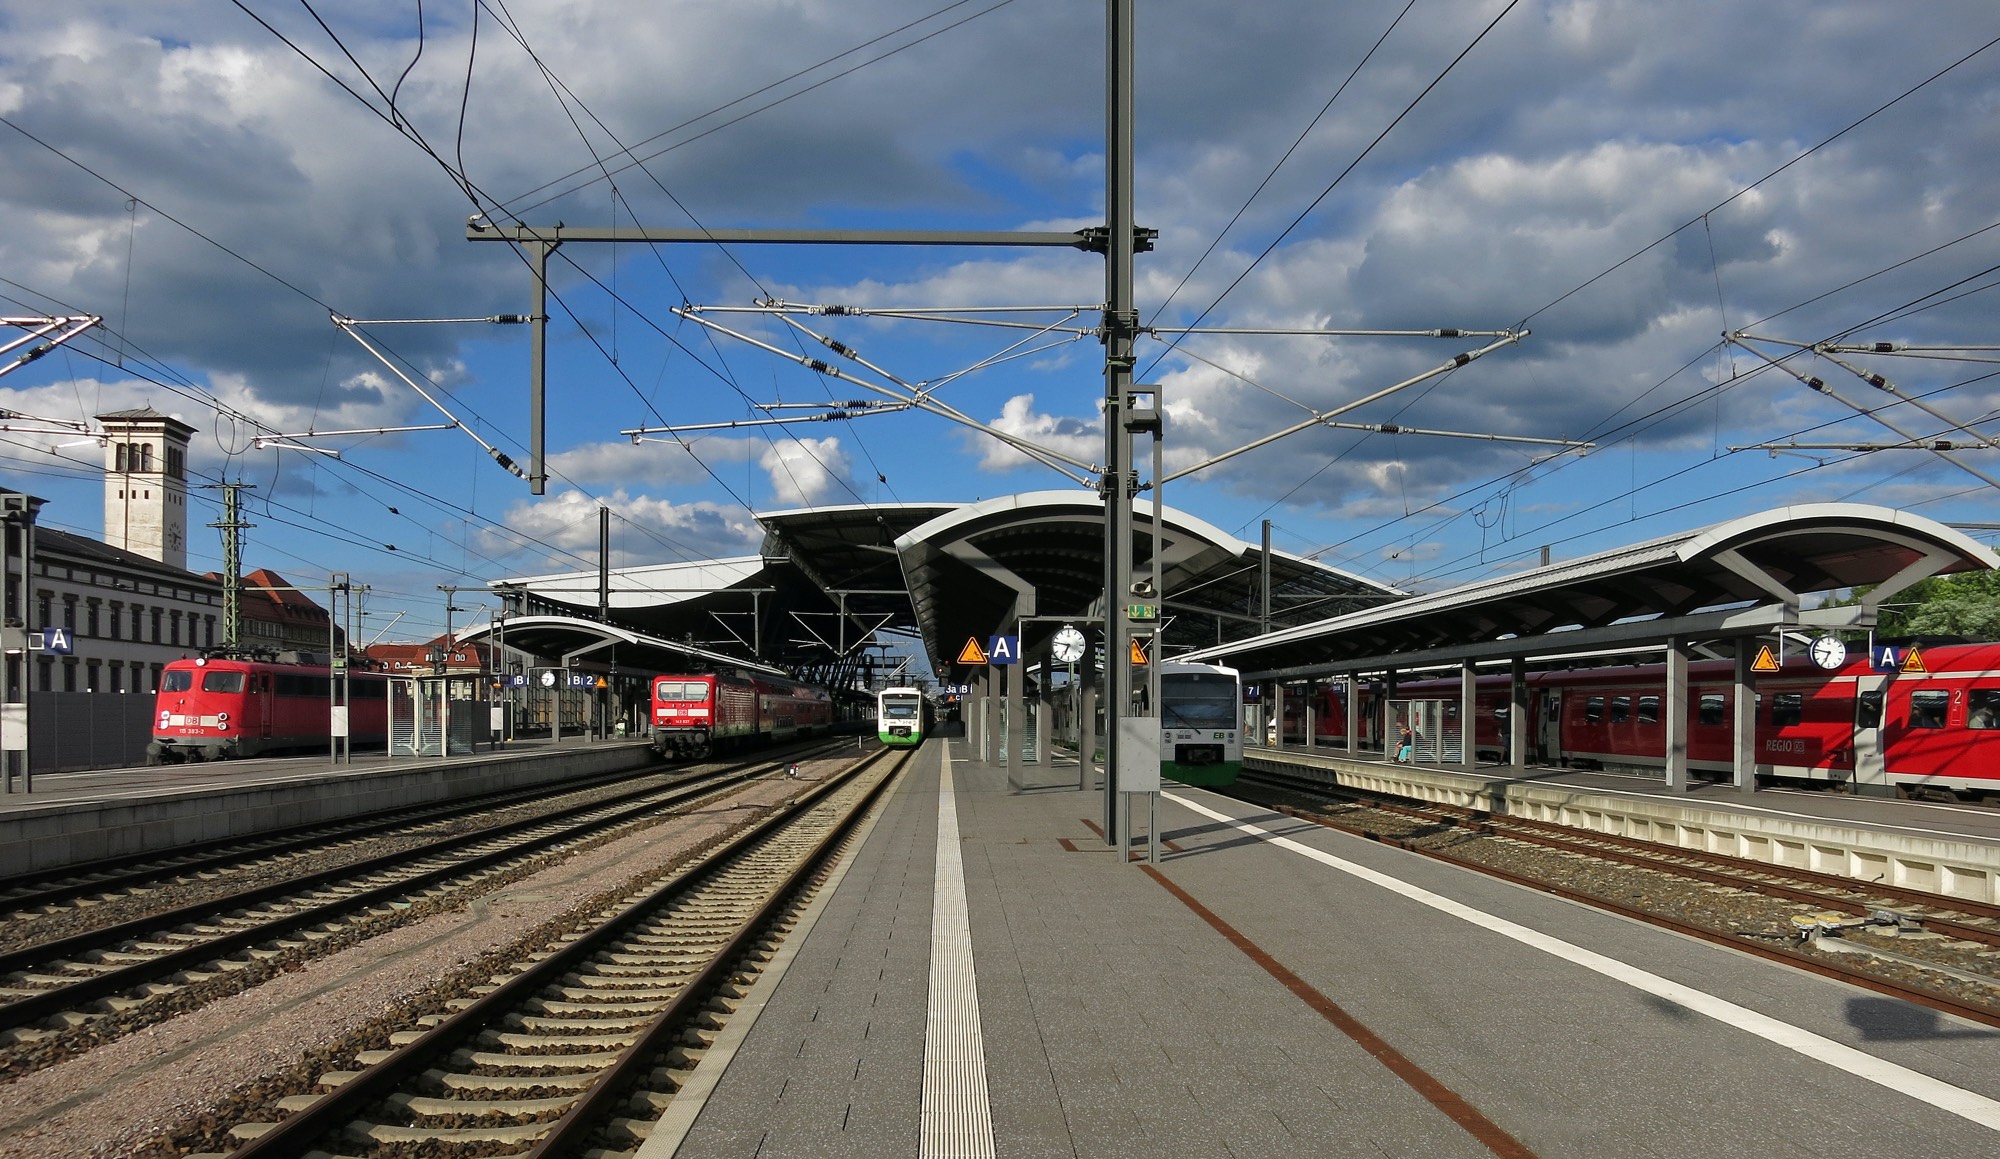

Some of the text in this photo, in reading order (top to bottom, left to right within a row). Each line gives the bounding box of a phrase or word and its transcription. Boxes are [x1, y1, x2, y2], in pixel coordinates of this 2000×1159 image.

[51, 628, 68, 649] A
[993, 637, 1011, 658] A
[1880, 647, 1896, 667] A
[516, 675, 524, 685] B
[573, 675, 581, 685] B
[586, 675, 594, 685] 2
[945, 684, 957, 694] 3a
[961, 684, 968, 694] B
[1248, 686, 1254, 695] 7
[1954, 690, 1962, 704] 2
[186, 717, 198, 725] DB
[1765, 740, 1792, 752] REGIO
